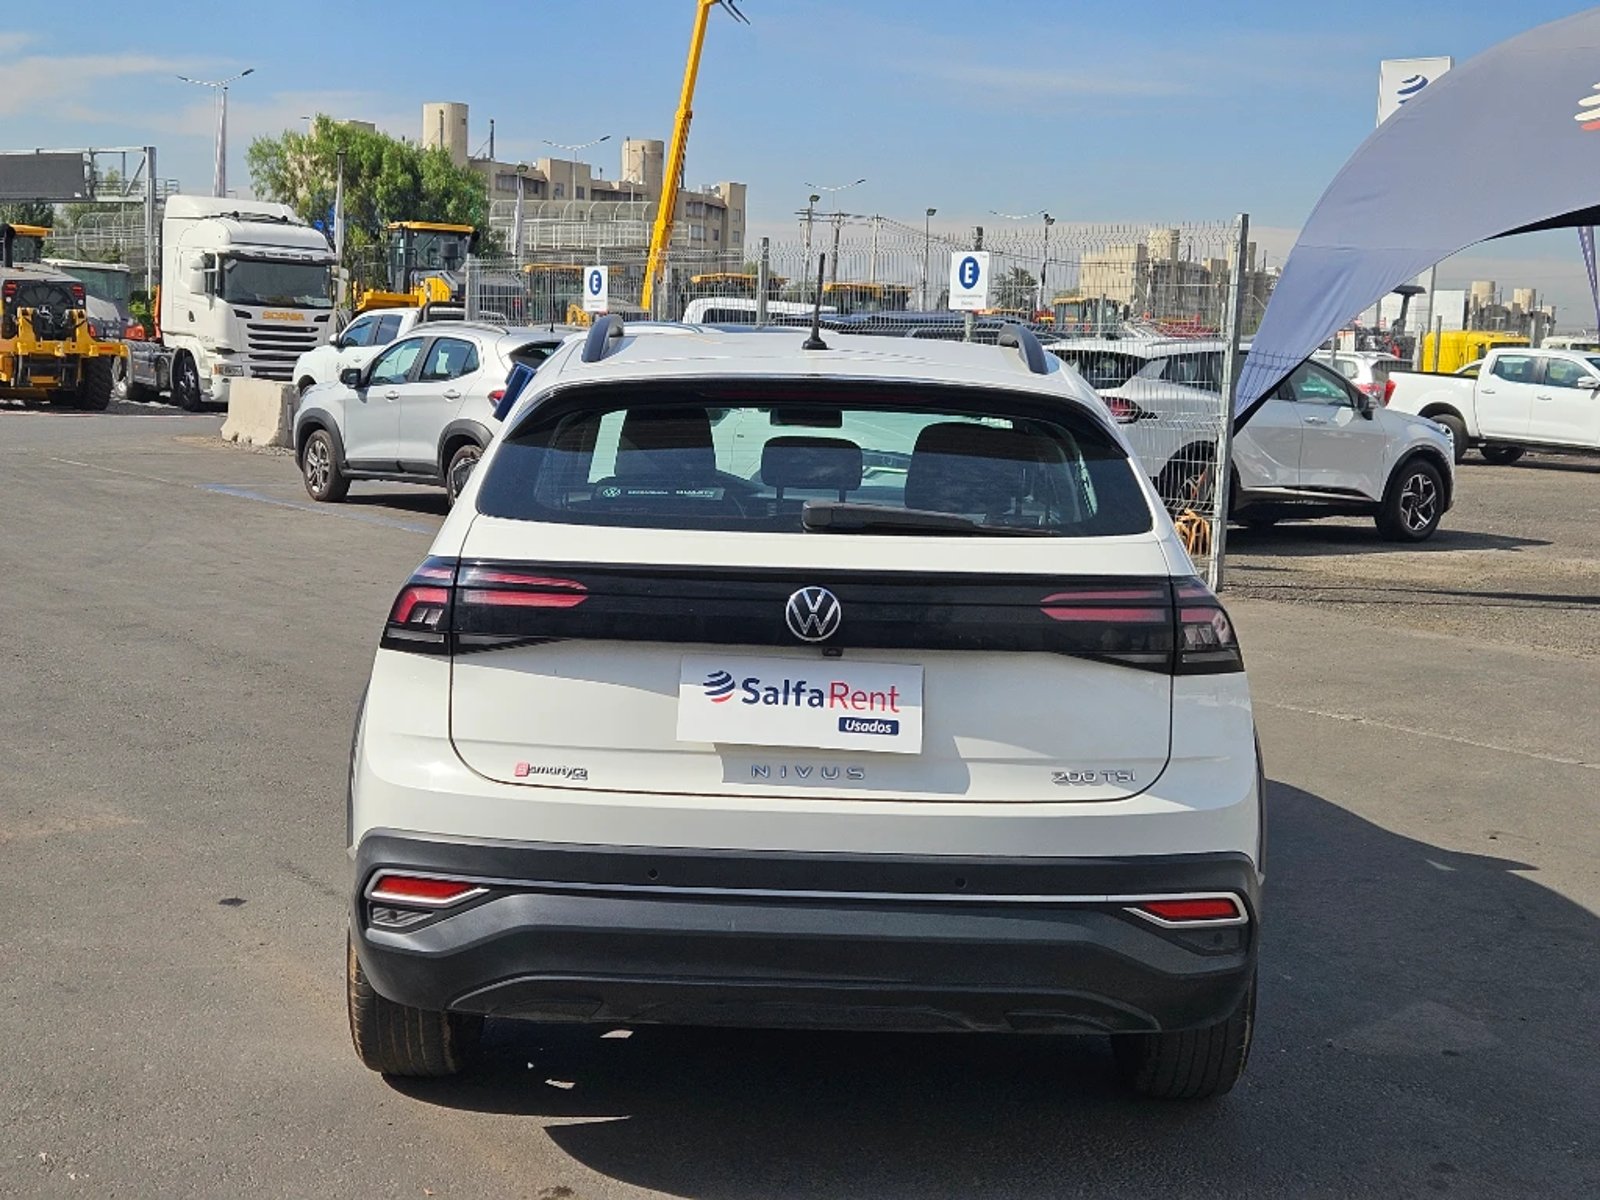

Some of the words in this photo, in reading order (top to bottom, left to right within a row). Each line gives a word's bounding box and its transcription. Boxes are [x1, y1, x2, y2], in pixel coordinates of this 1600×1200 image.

[965, 262, 974, 283] E
[262, 311, 305, 321] SCANIA
[741, 677, 900, 713] SalfaRent
[845, 719, 892, 734] Usados
[751, 764, 865, 781] NIVUS
[1051, 770, 1096, 784] 200
[1100, 769, 1136, 783] TSI
